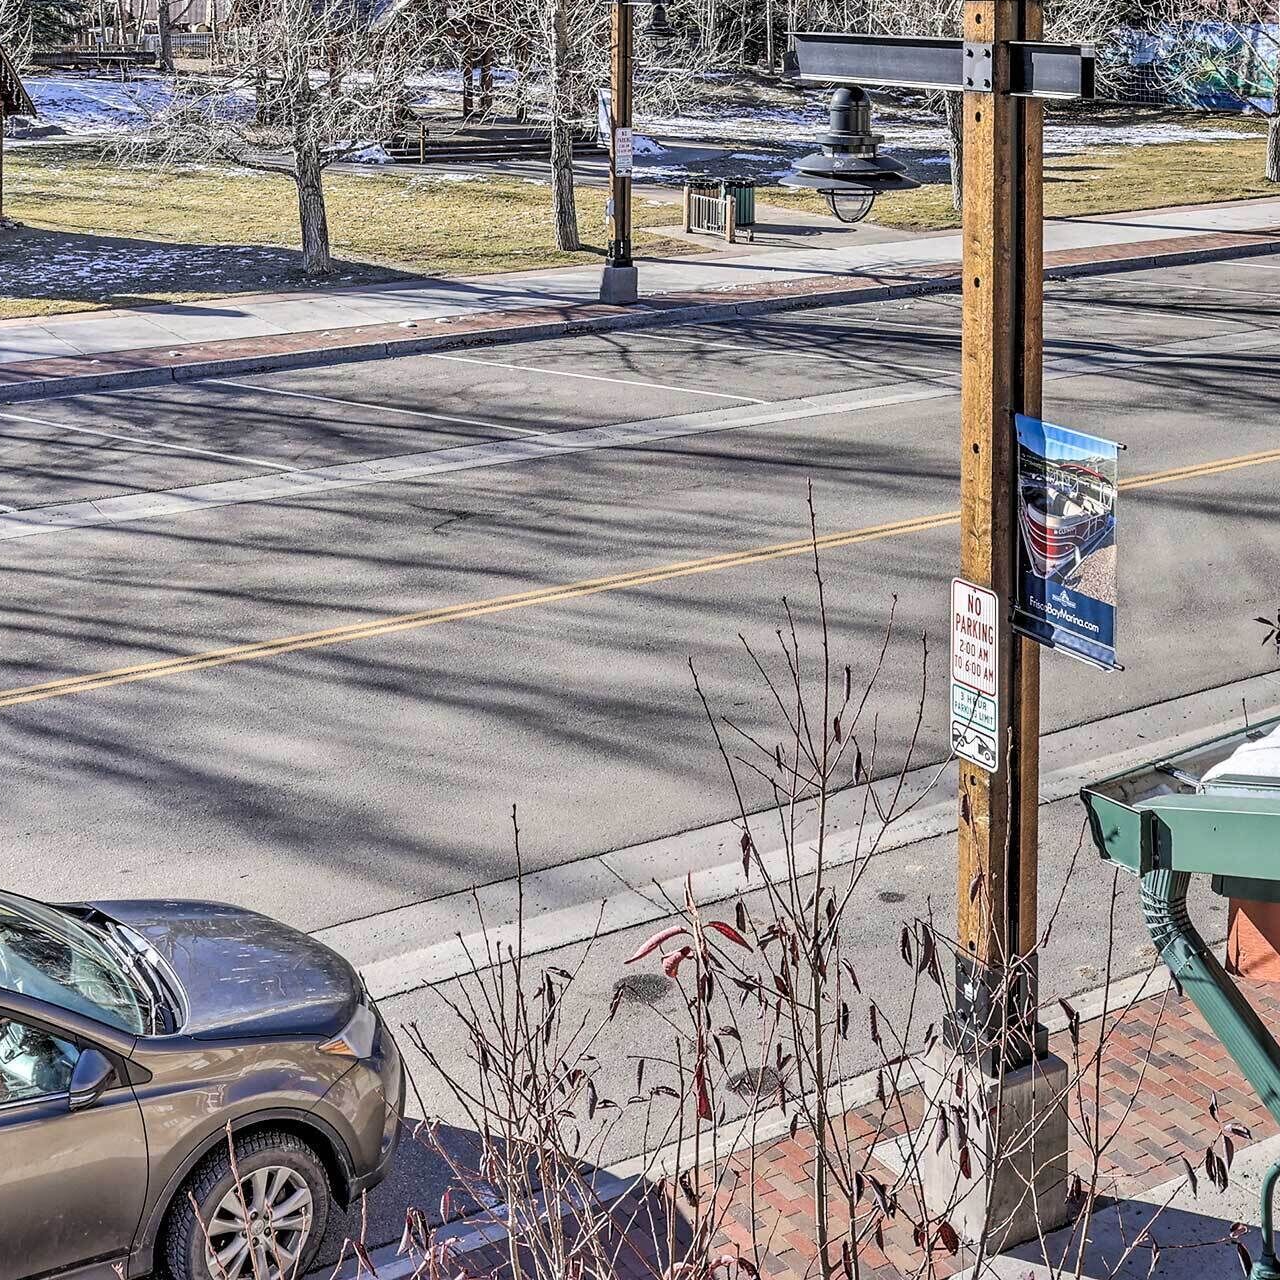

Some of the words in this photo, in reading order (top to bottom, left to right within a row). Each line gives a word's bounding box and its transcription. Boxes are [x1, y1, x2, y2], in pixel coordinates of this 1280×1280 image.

[967, 593, 982, 616] NO
[1029, 595, 1099, 633] FriscoBayMarina.com
[955, 612, 994, 646] PARKING
[959, 639, 976, 657] 2:00
[978, 647, 989, 662] AM
[954, 654, 963, 669] TO
[964, 660, 982, 677] 6:00
[983, 668, 994, 683] AM
[978, 711, 994, 726] LIMIT
